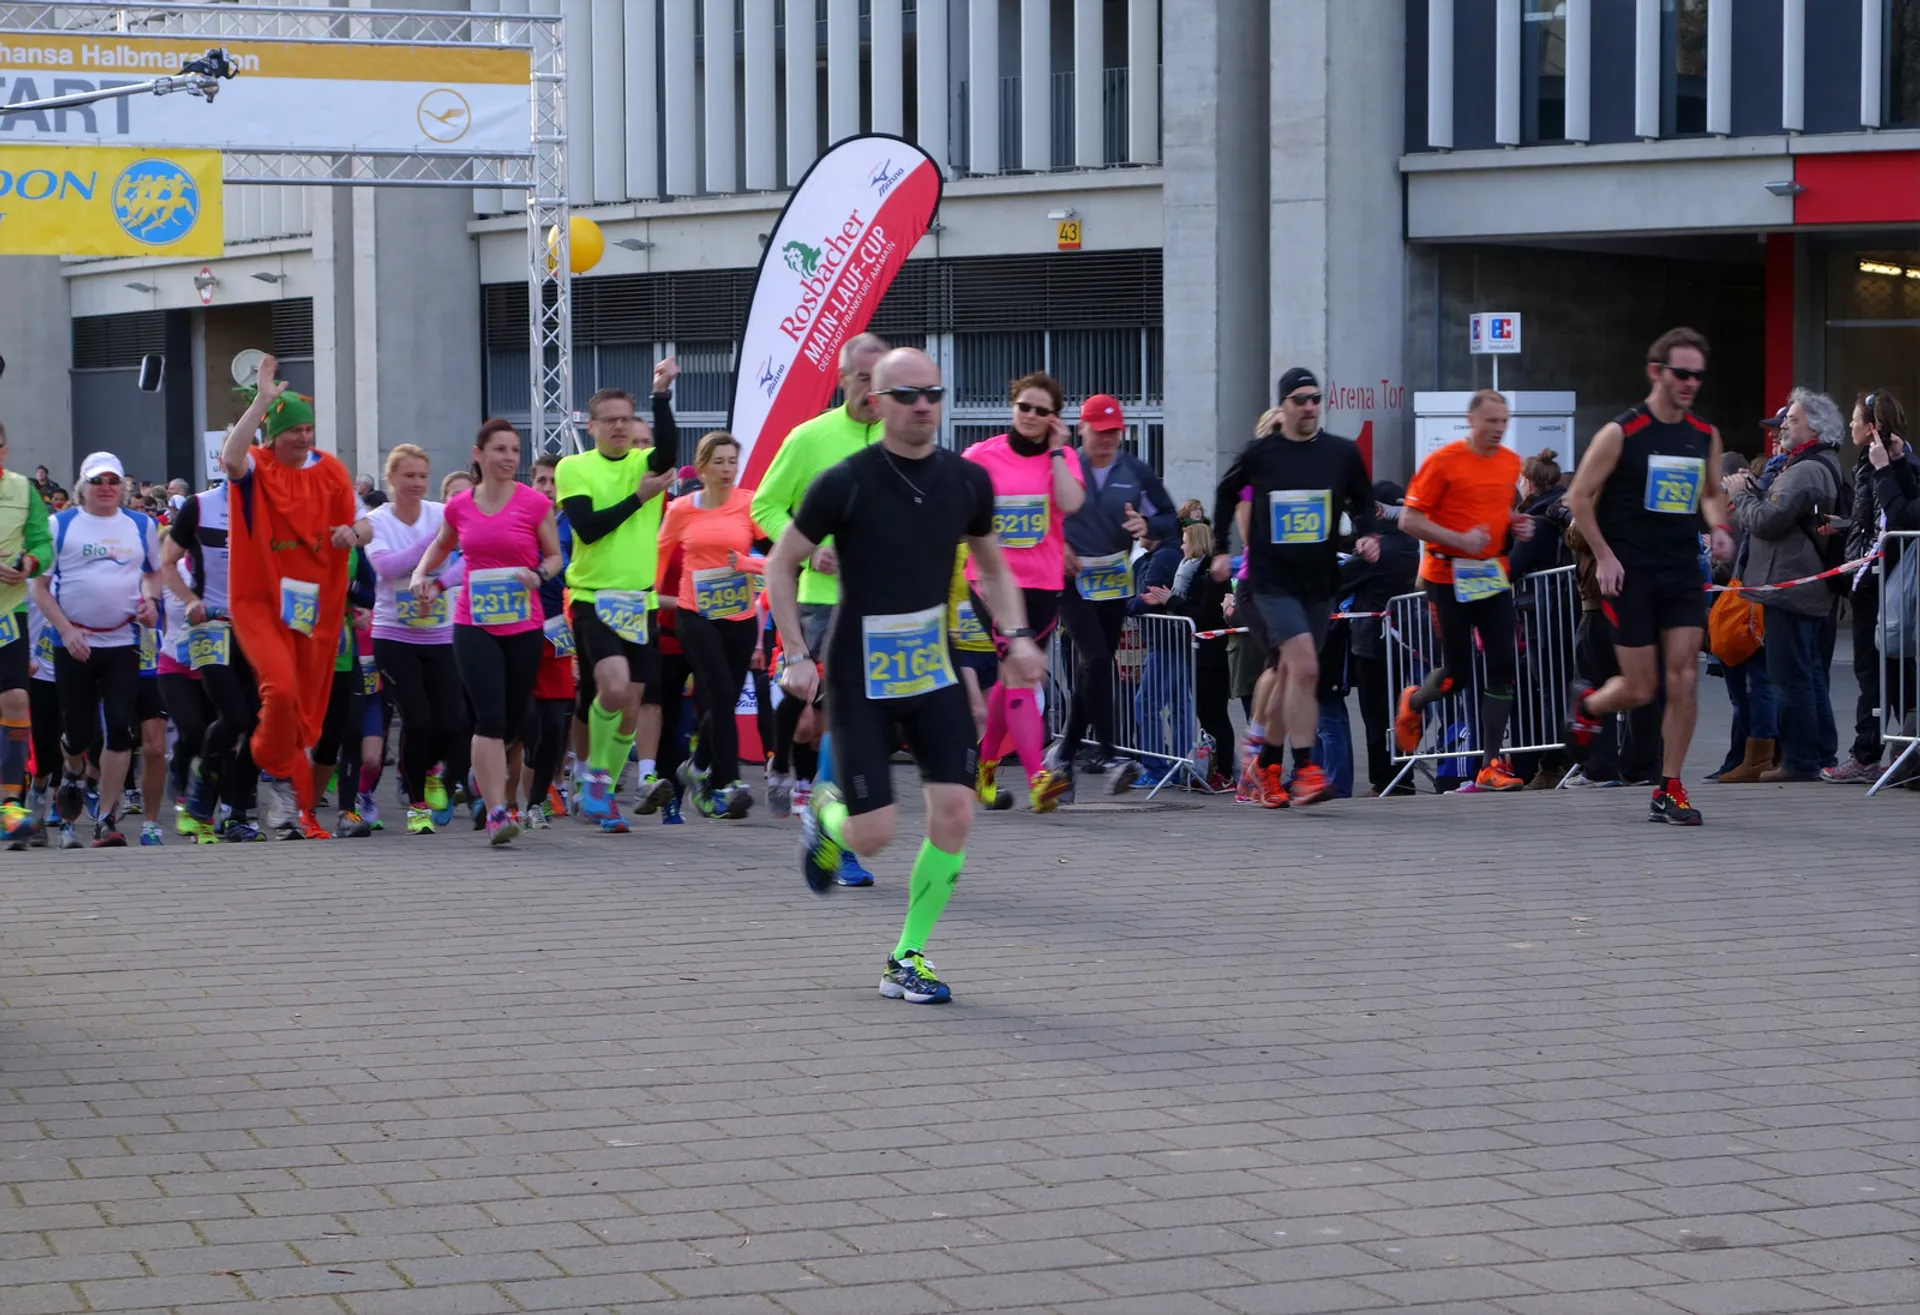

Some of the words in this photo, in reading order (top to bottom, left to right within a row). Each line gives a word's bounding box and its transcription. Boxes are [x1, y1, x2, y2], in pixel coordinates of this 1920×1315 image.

[0, 76, 144, 135] ART
[1060, 223, 1077, 241] 43
[779, 208, 865, 343] Rosbacher
[804, 225, 887, 365] MAIN-LAUF-CUP
[818, 353, 832, 373] DER
[829, 327, 845, 354] STADT
[843, 279, 873, 329] FRANKFURT
[871, 264, 883, 280] AM
[878, 240, 896, 266] MAIN
[1328, 380, 1375, 410] Arena
[1381, 379, 1405, 409] Tor
[992, 514, 1045, 533] 6219
[1280, 512, 1320, 532] 150
[397, 598, 445, 618] 232
[473, 591, 526, 613] 2317
[699, 586, 748, 609] 5494
[869, 643, 942, 680] 2162
